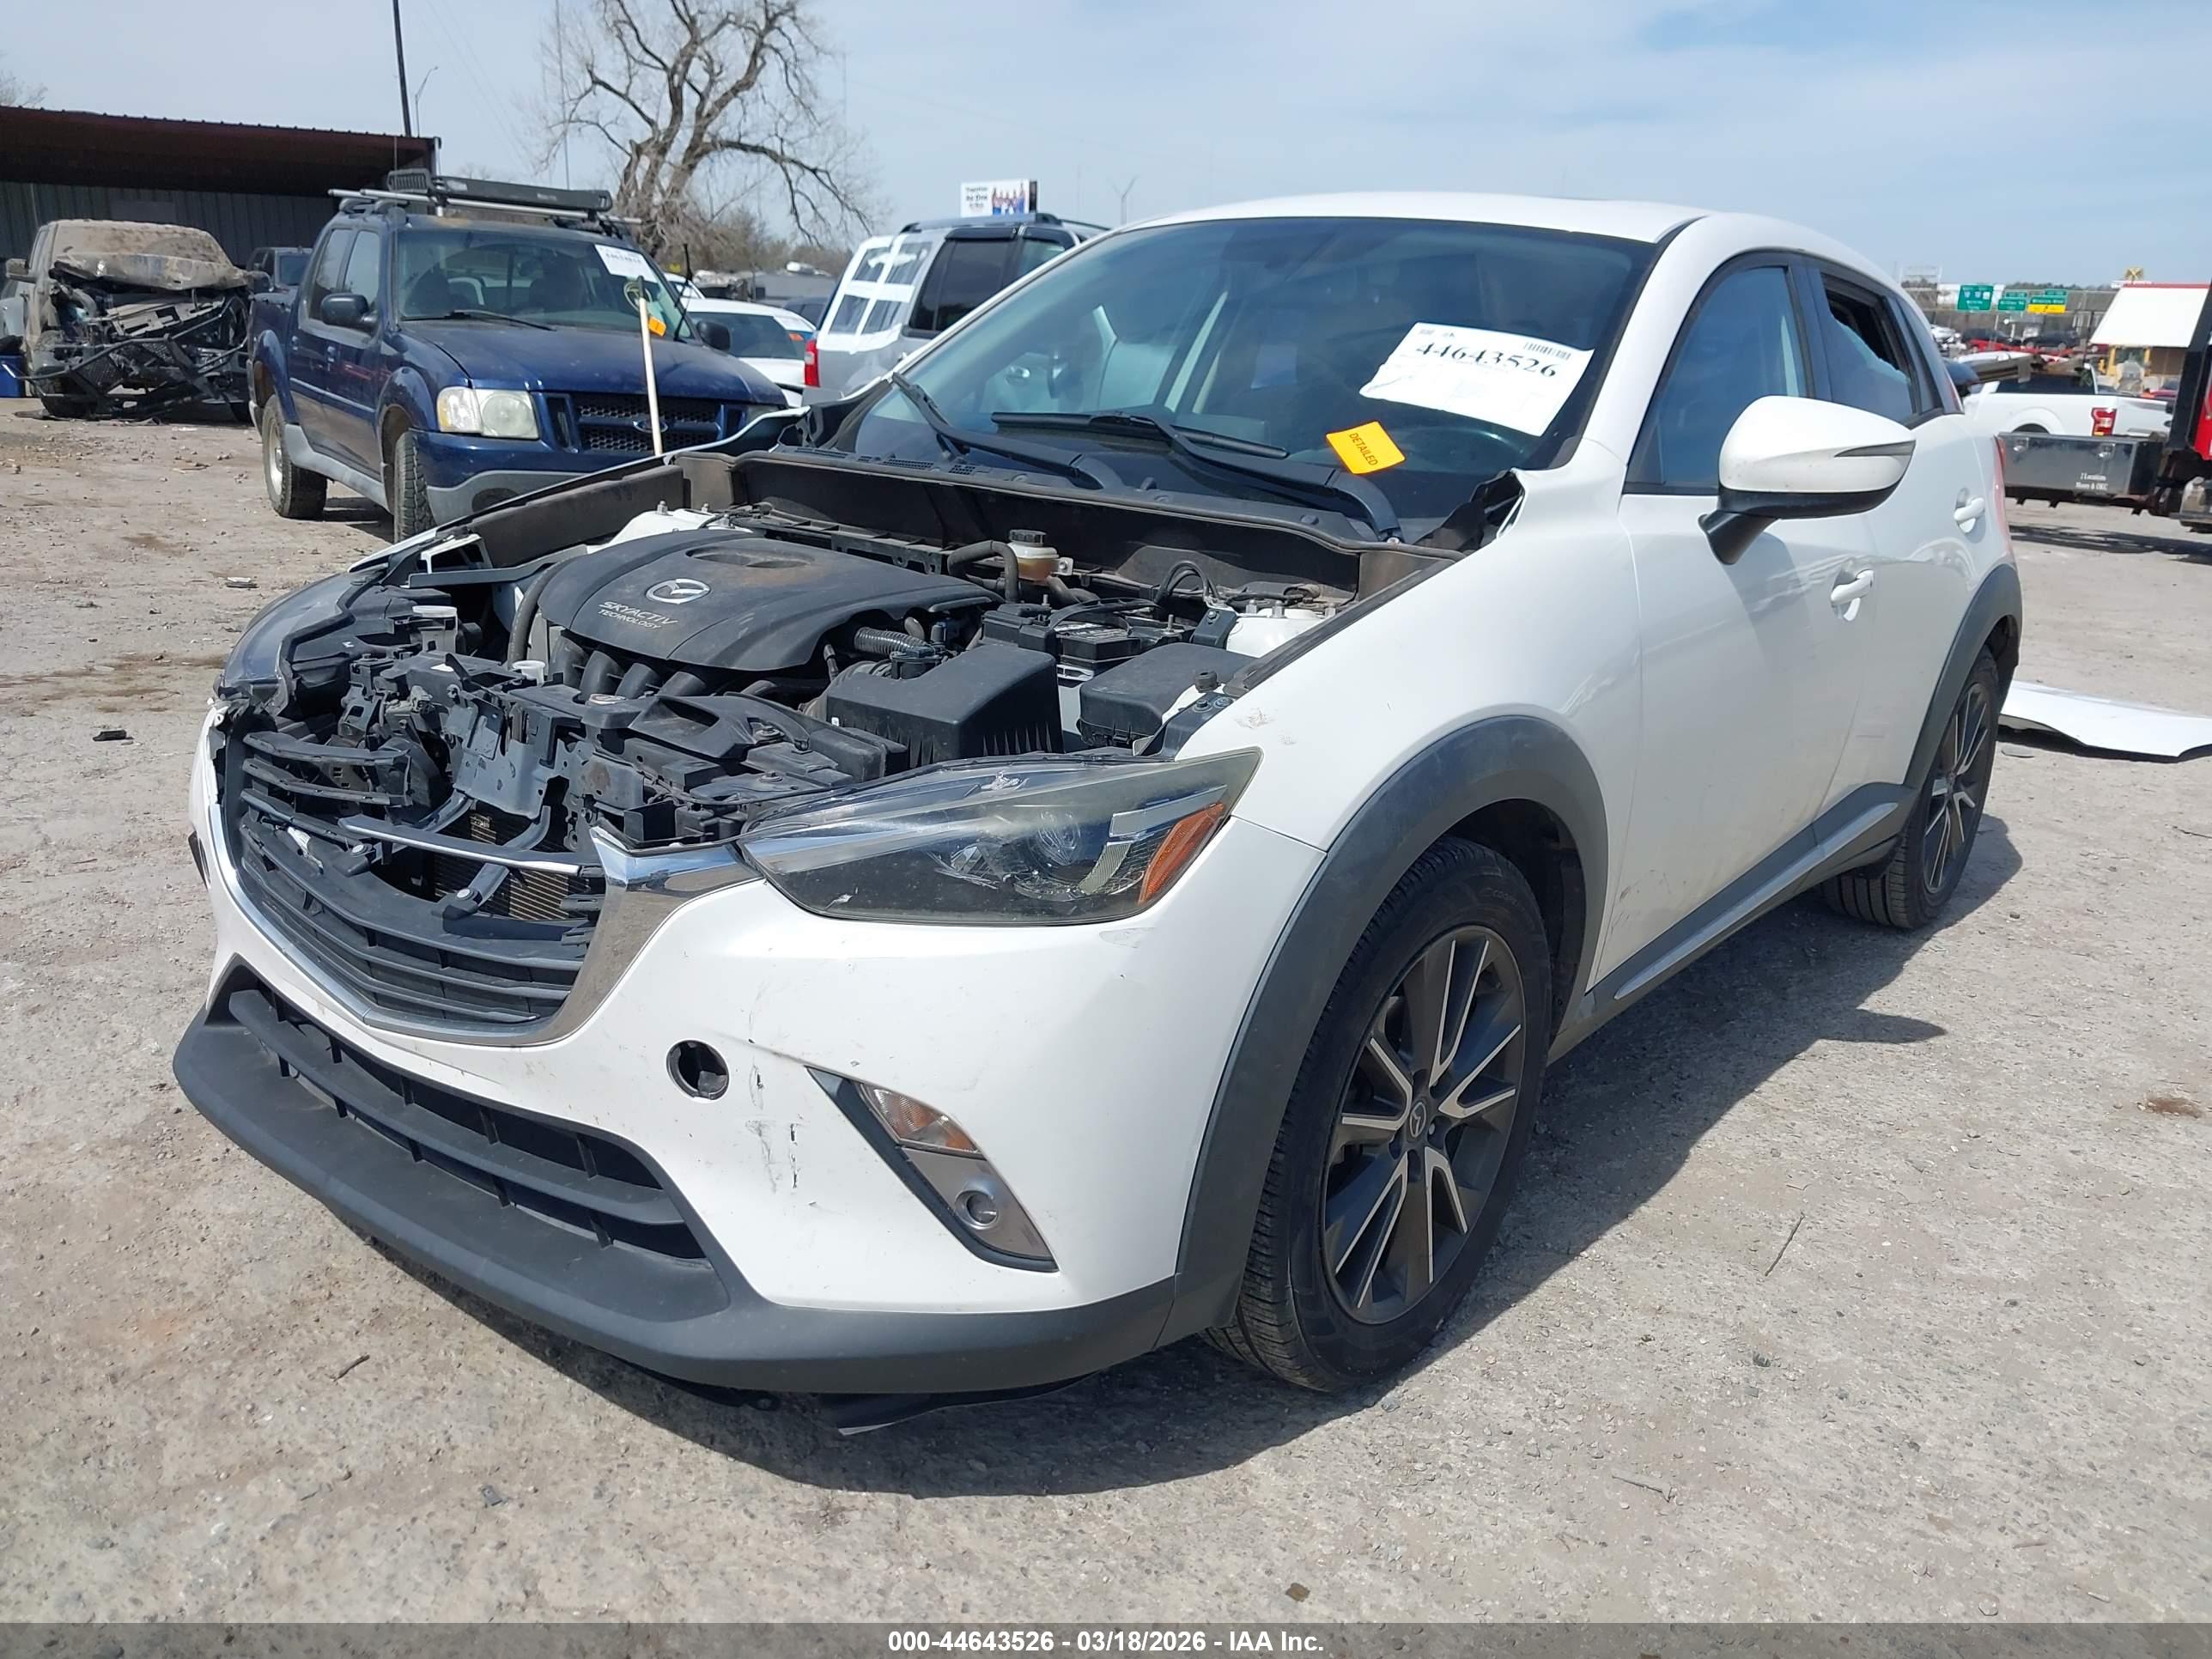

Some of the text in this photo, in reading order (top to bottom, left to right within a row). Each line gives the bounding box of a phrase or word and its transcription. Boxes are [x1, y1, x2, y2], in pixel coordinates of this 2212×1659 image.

[1415, 342, 1559, 377] 44643526
[1349, 432, 1378, 465] DETAILED
[598, 609, 662, 629] TECHNOLOGY
[599, 601, 678, 624] SKYACTIV
